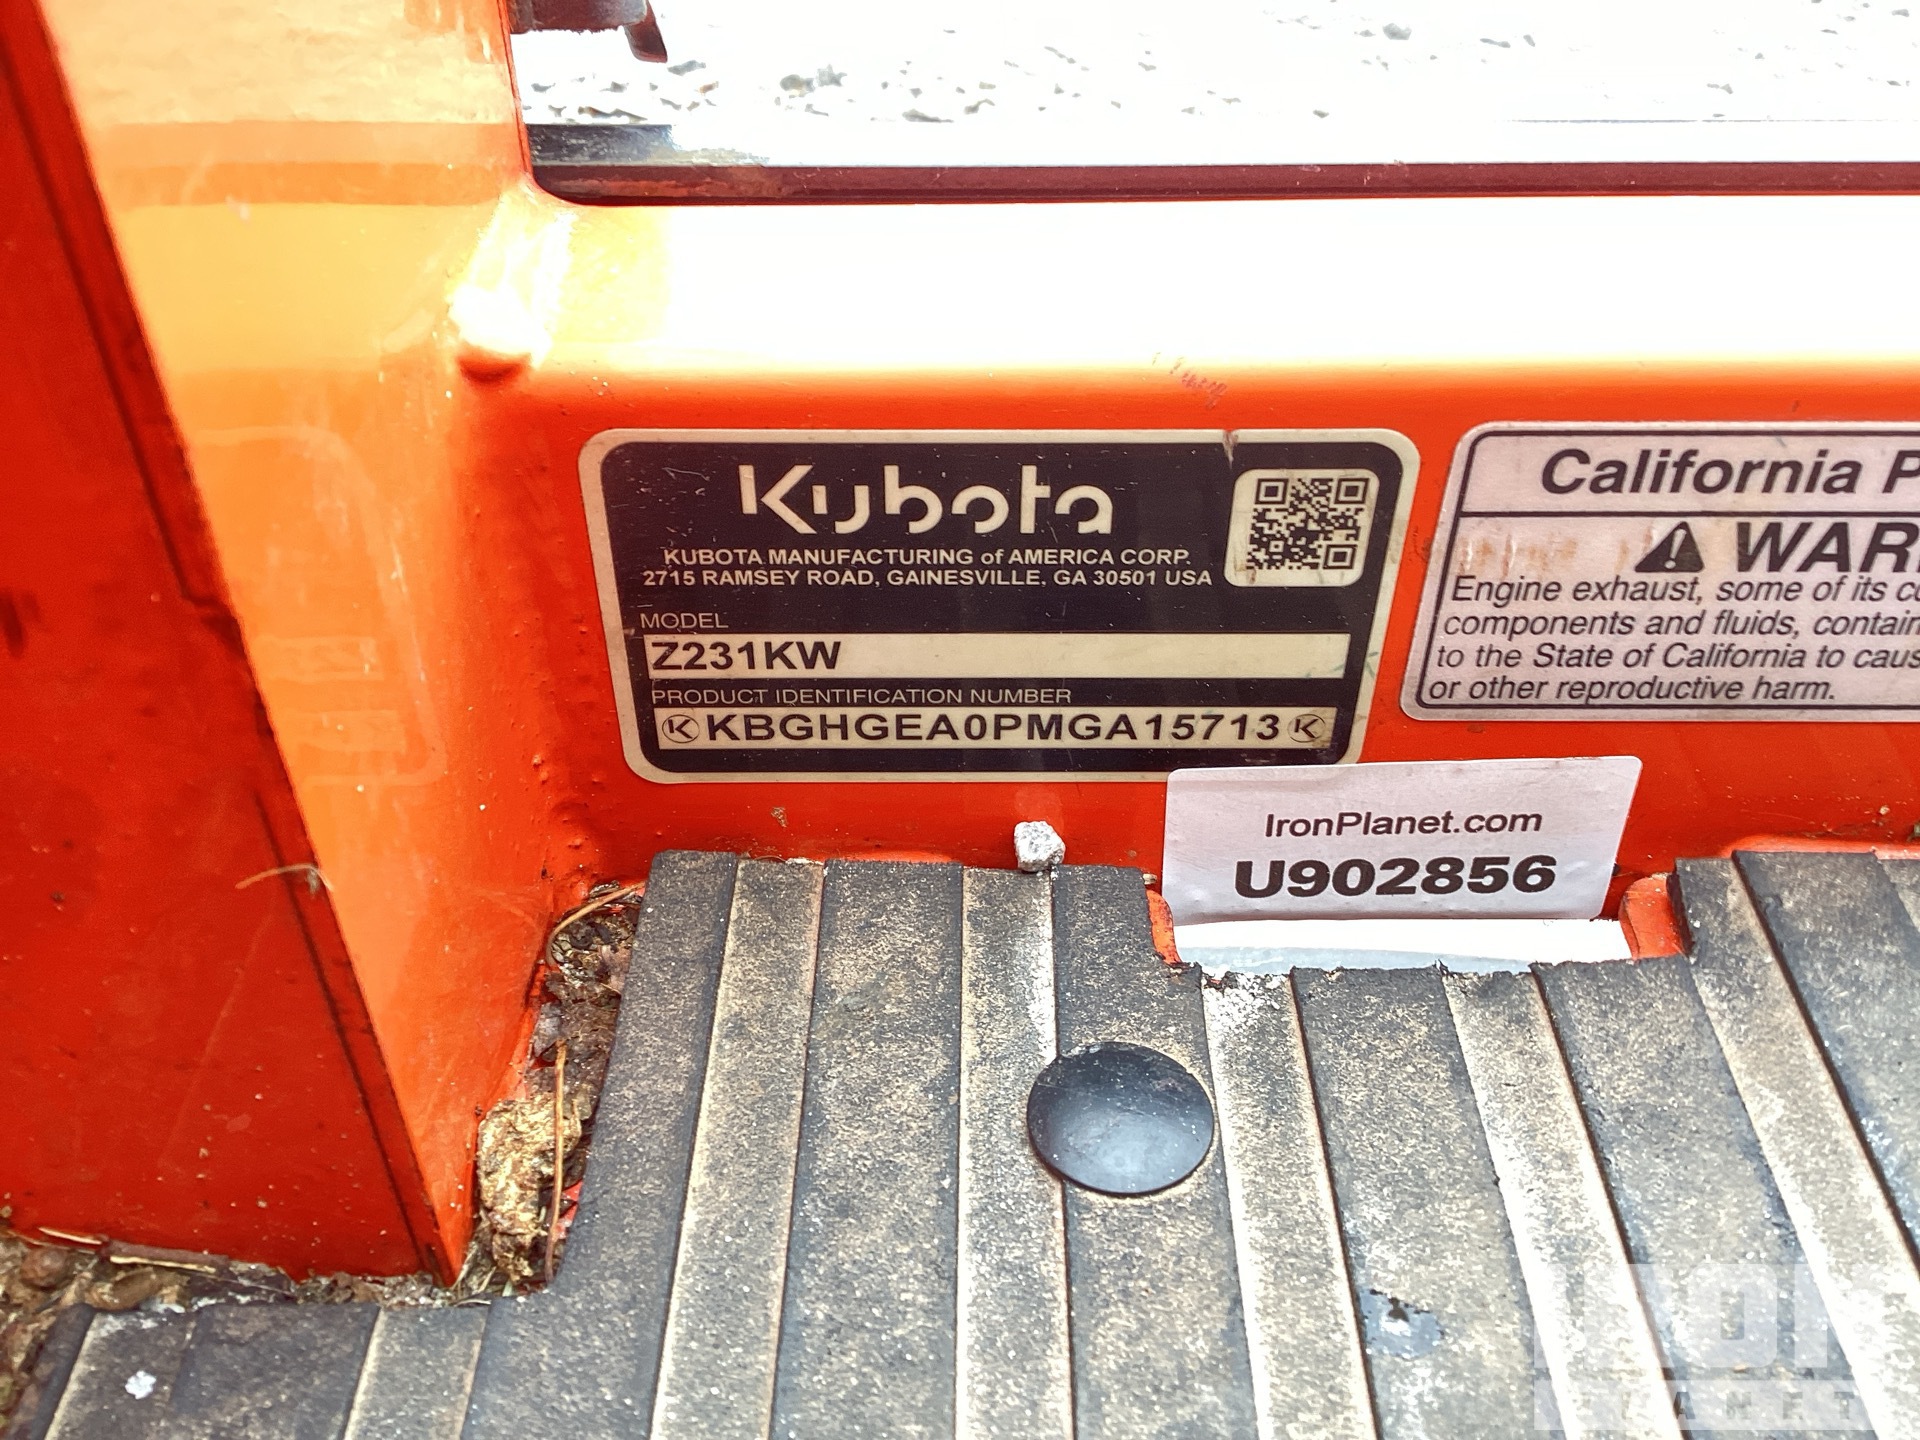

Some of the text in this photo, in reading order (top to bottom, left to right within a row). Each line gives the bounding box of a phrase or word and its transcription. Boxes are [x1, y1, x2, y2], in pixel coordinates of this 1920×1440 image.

[1541, 448, 1863, 494] California
[738, 464, 1114, 534] Kubota
[663, 548, 1191, 566] KUBOTA MANUFACTURING of AMERICA CORP.
[1736, 521, 1920, 573] WAR
[643, 569, 1213, 588] 2715 RAMSEY ROAD, GAINESVILLE, GA 30501 USA
[1452, 574, 1920, 608] Engine exhaust, some of its c
[640, 612, 729, 629] MODEL
[1443, 610, 1636, 641] components
[1644, 609, 1706, 636] and
[1712, 609, 1800, 640] fluids,
[652, 641, 842, 670] Z231KW
[1437, 645, 1465, 668] to
[1475, 643, 1522, 668] the
[1532, 642, 1614, 668] State
[1622, 642, 1657, 668] of
[1662, 642, 1807, 669] California
[1815, 644, 1846, 669] to
[653, 687, 1072, 705] PRODUCT IDENTIFICATION NUMBER
[1429, 675, 1835, 705] or other reproductive harm.
[706, 713, 1281, 742] KBGHGEA0PMGA15713
[1264, 811, 1543, 838] IronPlanet.com
[1235, 855, 1557, 898] U902856
